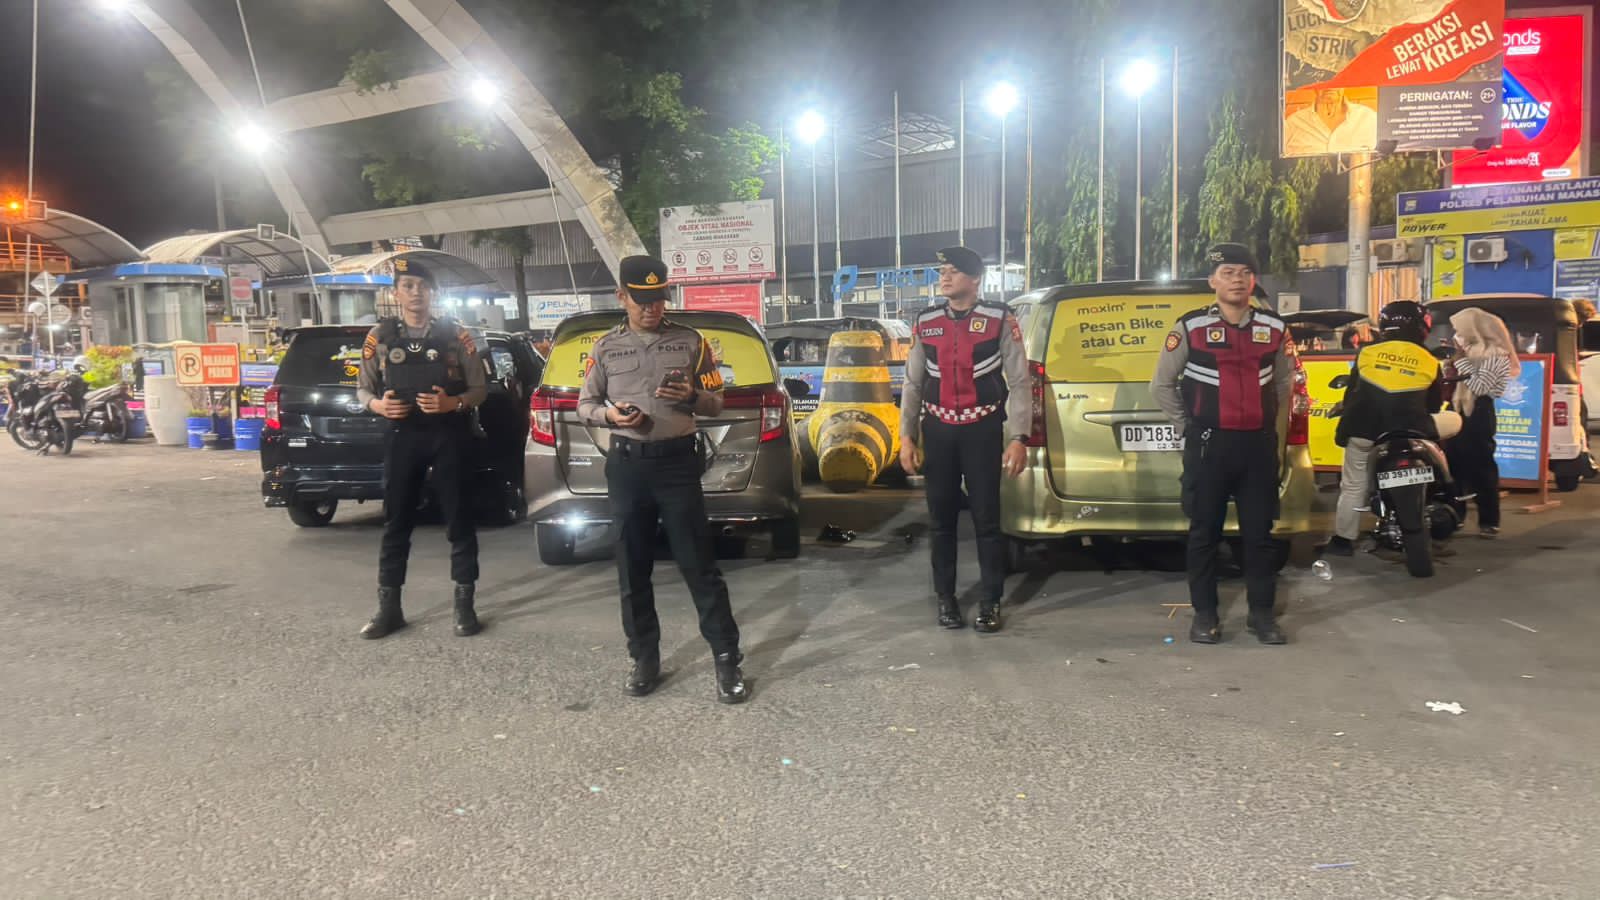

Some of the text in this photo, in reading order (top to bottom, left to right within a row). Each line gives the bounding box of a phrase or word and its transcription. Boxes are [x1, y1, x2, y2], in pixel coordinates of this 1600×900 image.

[1392, 11, 1462, 62] BERAKSI
[1385, 20, 1494, 80] LEWAT KREASI
[1399, 90, 1473, 103] PERINGATAN:
[1485, 193, 1555, 206] PELABUHAN
[1401, 223, 1448, 233] POWER
[1077, 303, 1124, 315] maxim
[1080, 318, 1164, 333] Pesan Bike
[657, 344, 688, 352] POLRI
[1081, 334, 1147, 349] atau Car
[1377, 351, 1419, 366] maxim
[1125, 427, 1142, 442] DD
